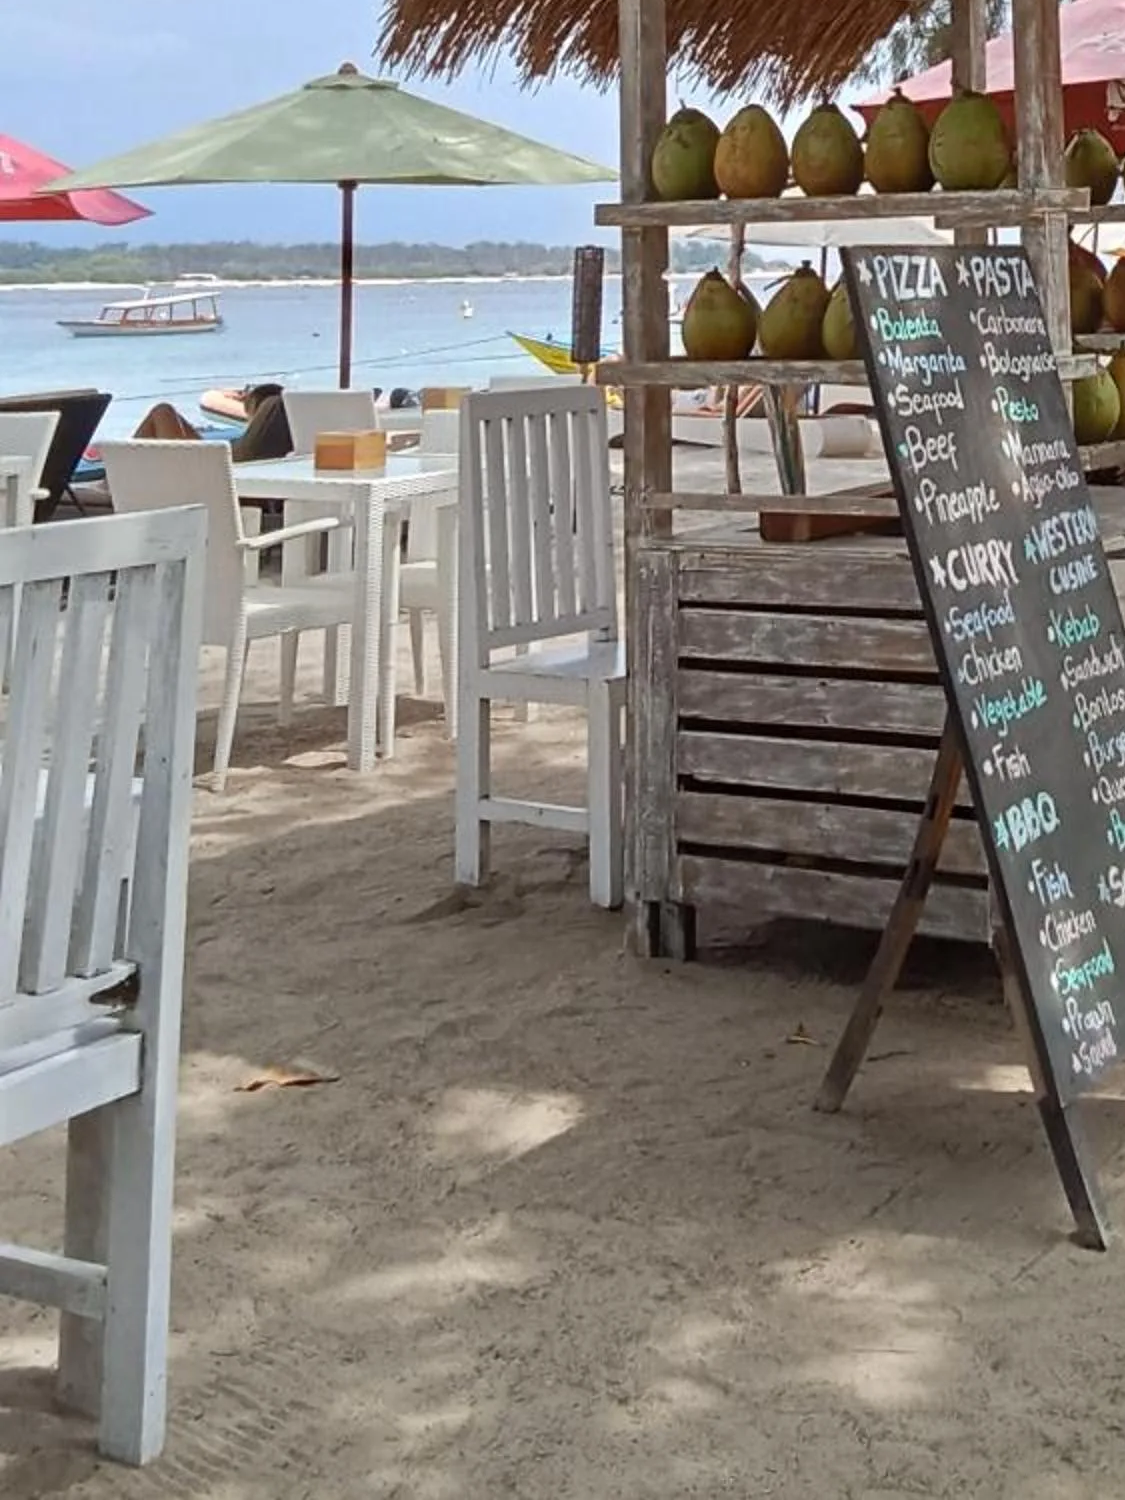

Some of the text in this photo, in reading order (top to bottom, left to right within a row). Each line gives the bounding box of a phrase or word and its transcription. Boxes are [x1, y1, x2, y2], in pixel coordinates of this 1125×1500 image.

[872, 255, 949, 300] PIZZA
[970, 255, 1039, 298] PASTA
[895, 383, 964, 426] Seafood
[995, 386, 1040, 422] Pesto
[905, 424, 958, 473] Beef
[919, 478, 1001, 527] Pineapple
[1031, 504, 1098, 562] WESTERN
[947, 539, 1020, 591] CURRY
[950, 587, 1016, 642] Seafood
[1051, 603, 1100, 648] Kebab
[962, 640, 1024, 686] Chicken
[975, 676, 1048, 737] Vegetable
[992, 742, 1032, 783] Fish
[1006, 790, 1061, 853] BBQ
[1032, 858, 1075, 906] Fish
[1044, 908, 1097, 952] Chicken
[1056, 937, 1116, 995] Seafood
[1066, 995, 1118, 1039] Prawn
